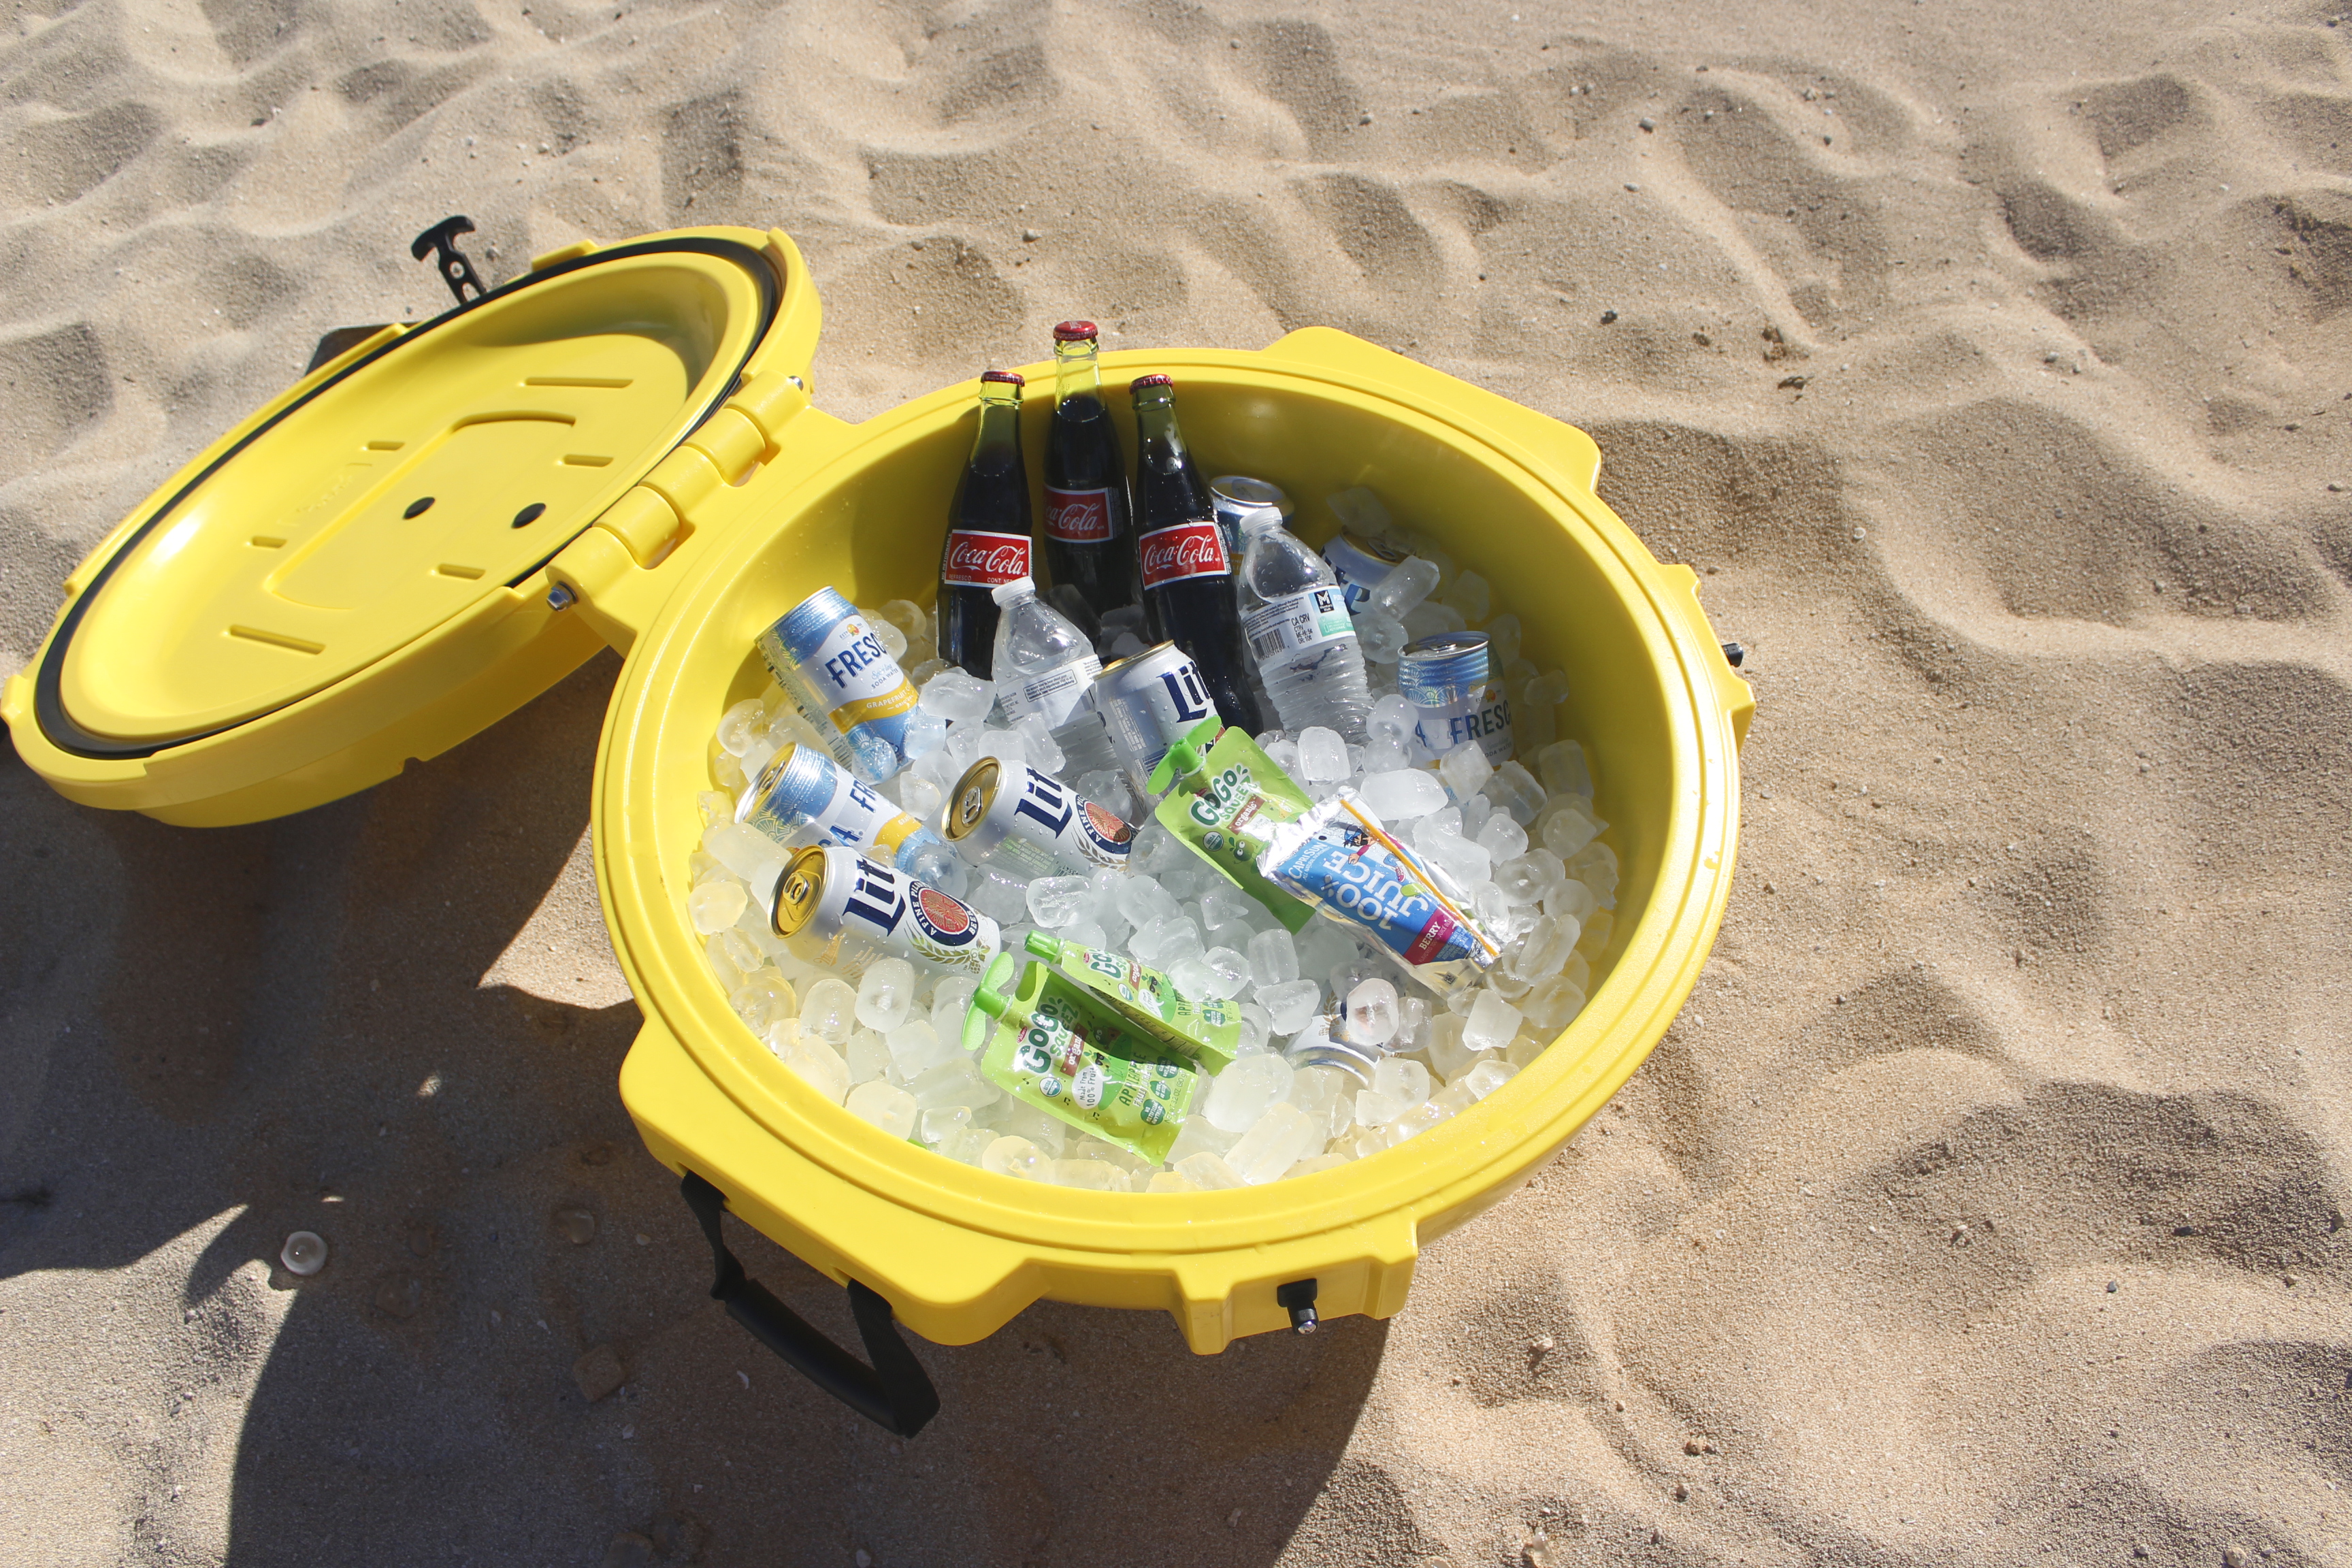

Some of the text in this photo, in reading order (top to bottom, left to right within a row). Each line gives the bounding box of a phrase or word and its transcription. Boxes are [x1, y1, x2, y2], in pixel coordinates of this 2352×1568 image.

[950, 542, 1026, 575] Coca-Cola
[1144, 535, 1213, 574] Coca-Cola
[1291, 612, 1311, 626] CA CRV
[871, 668, 899, 689] SODA WATER
[866, 691, 906, 709] GRAPEFRUIT
[1484, 750, 1497, 758] ODA
[1079, 809, 1094, 835] FINE
[1235, 800, 1258, 827] organic
[1206, 834, 1216, 845] USDA
[1288, 842, 1328, 879] CAPRI SUN
[1322, 850, 1428, 918] JUICE
[913, 901, 930, 928] FINE
[1321, 874, 1399, 931] 100%
[930, 926, 938, 936] A
[967, 909, 979, 935] BEER
[1437, 926, 1448, 938] JUICE
[1418, 921, 1441, 951] BERRY
[1079, 1084, 1088, 1101] Made
[1086, 1066, 1097, 1107] 100% Fruit
[1132, 1085, 1148, 1108] FRUIT
